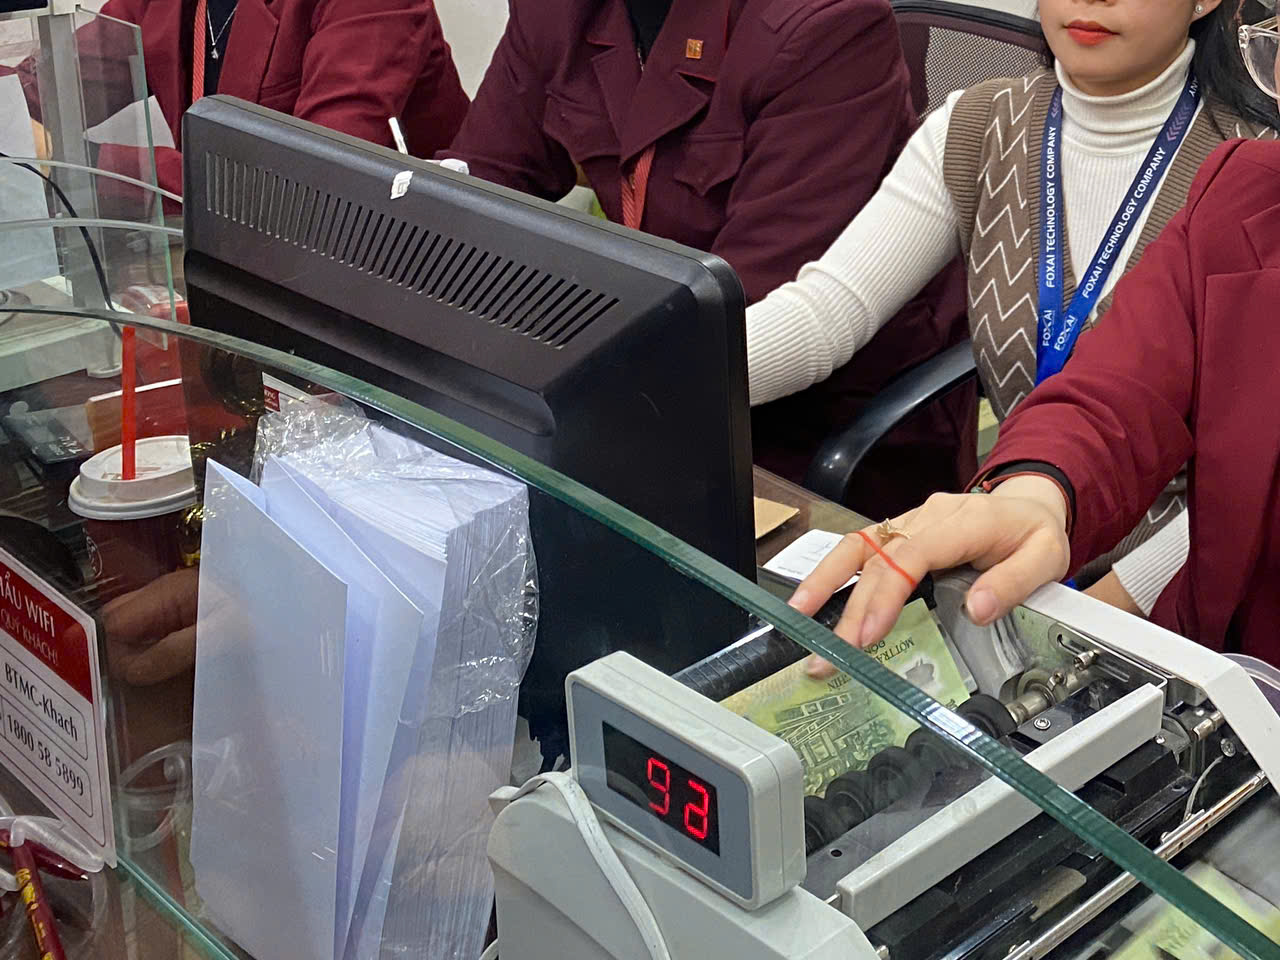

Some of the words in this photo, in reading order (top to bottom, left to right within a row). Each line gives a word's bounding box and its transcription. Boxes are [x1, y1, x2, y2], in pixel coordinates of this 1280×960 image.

[1047, 126, 1057, 178] COMPANY
[1046, 181, 1055, 253] TECHNOLOGY
[1082, 264, 1104, 299] FOXAI
[1098, 200, 1138, 265] TECHNOLOGY
[1134, 146, 1167, 199] COMPANY
[1046, 254, 1055, 288] FOXAI
[1042, 310, 1052, 346] FOXAI
[1054, 315, 1076, 351] FOXAI
[25, 595, 55, 638] WIFI
[5, 662, 78, 742] BTMC-Khach
[7, 715, 34, 752] 1800
[38, 741, 52, 768] 58
[55, 757, 84, 796] 5899
